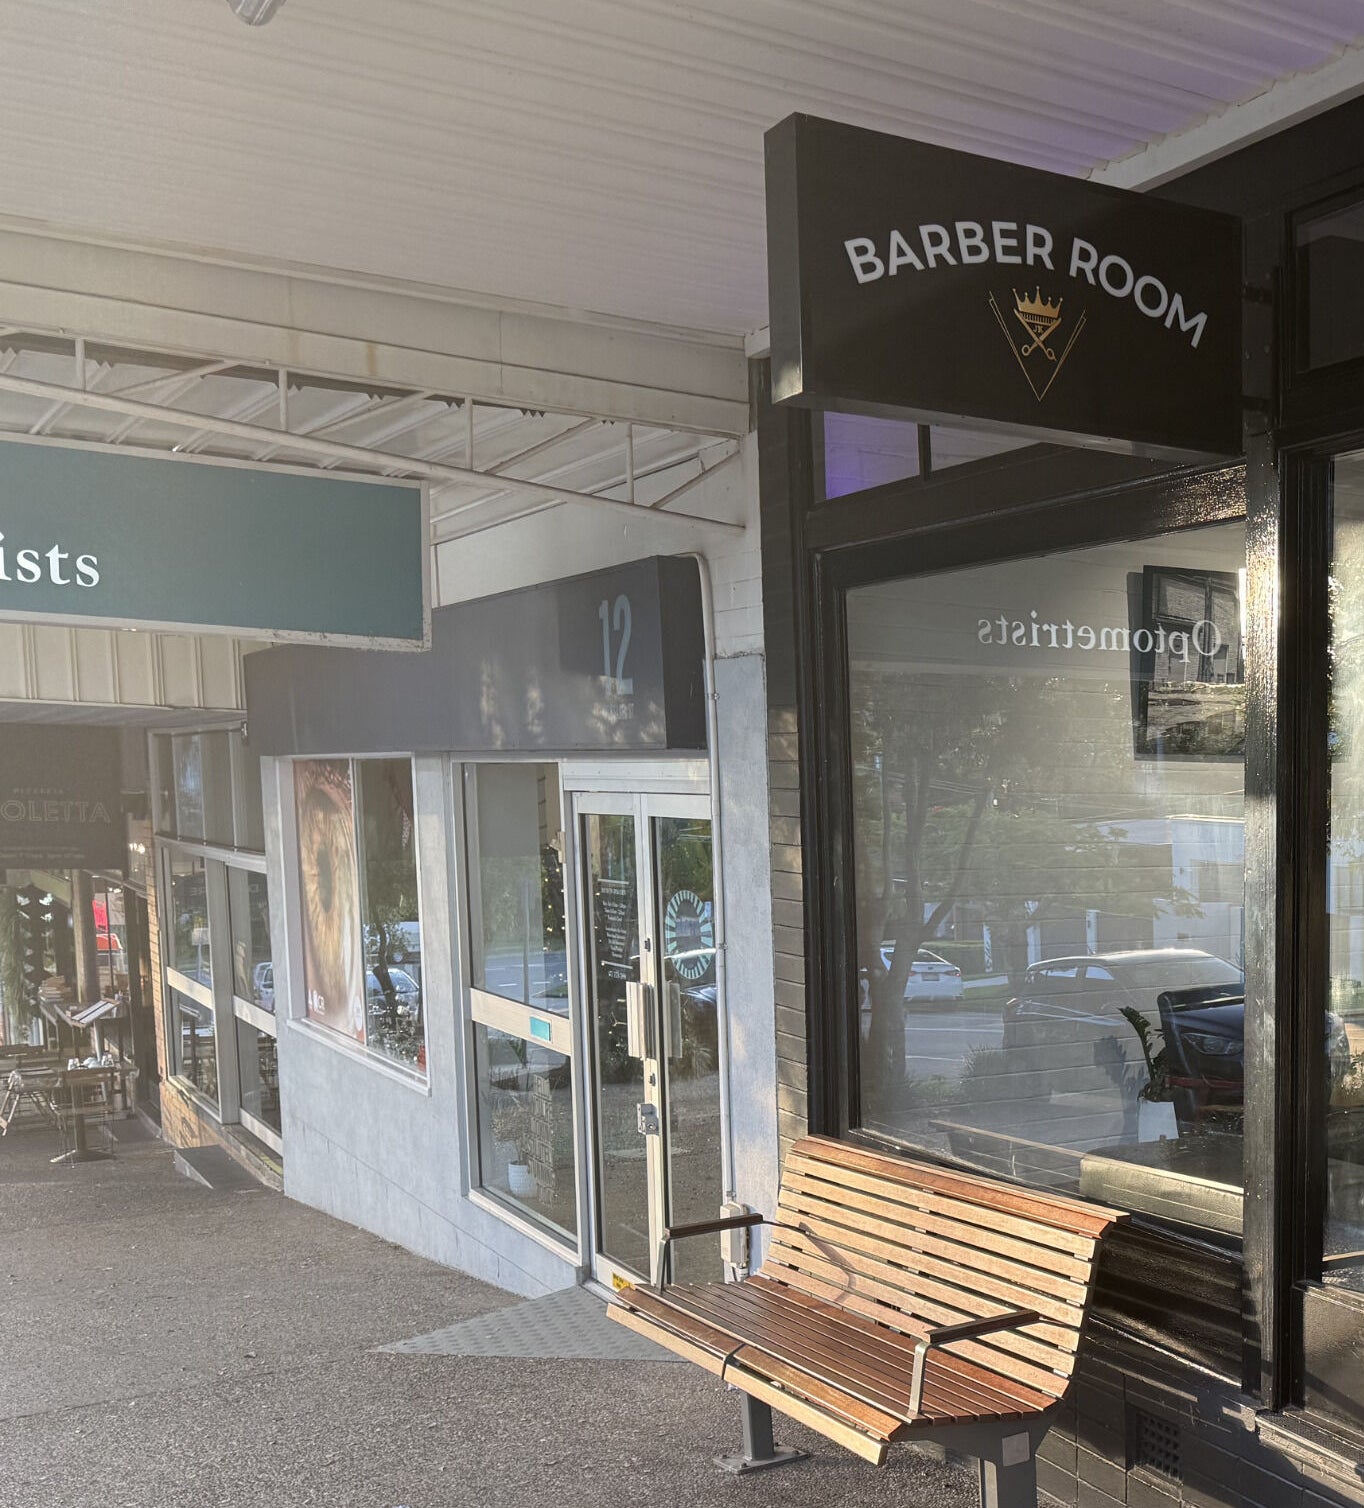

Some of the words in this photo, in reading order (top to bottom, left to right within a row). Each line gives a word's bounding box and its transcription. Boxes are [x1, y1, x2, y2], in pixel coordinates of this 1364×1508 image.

[844, 220, 1055, 284] BARBER
[1069, 236, 1208, 349] ROOM
[0, 531, 100, 587] ists
[598, 594, 633, 696] 12
